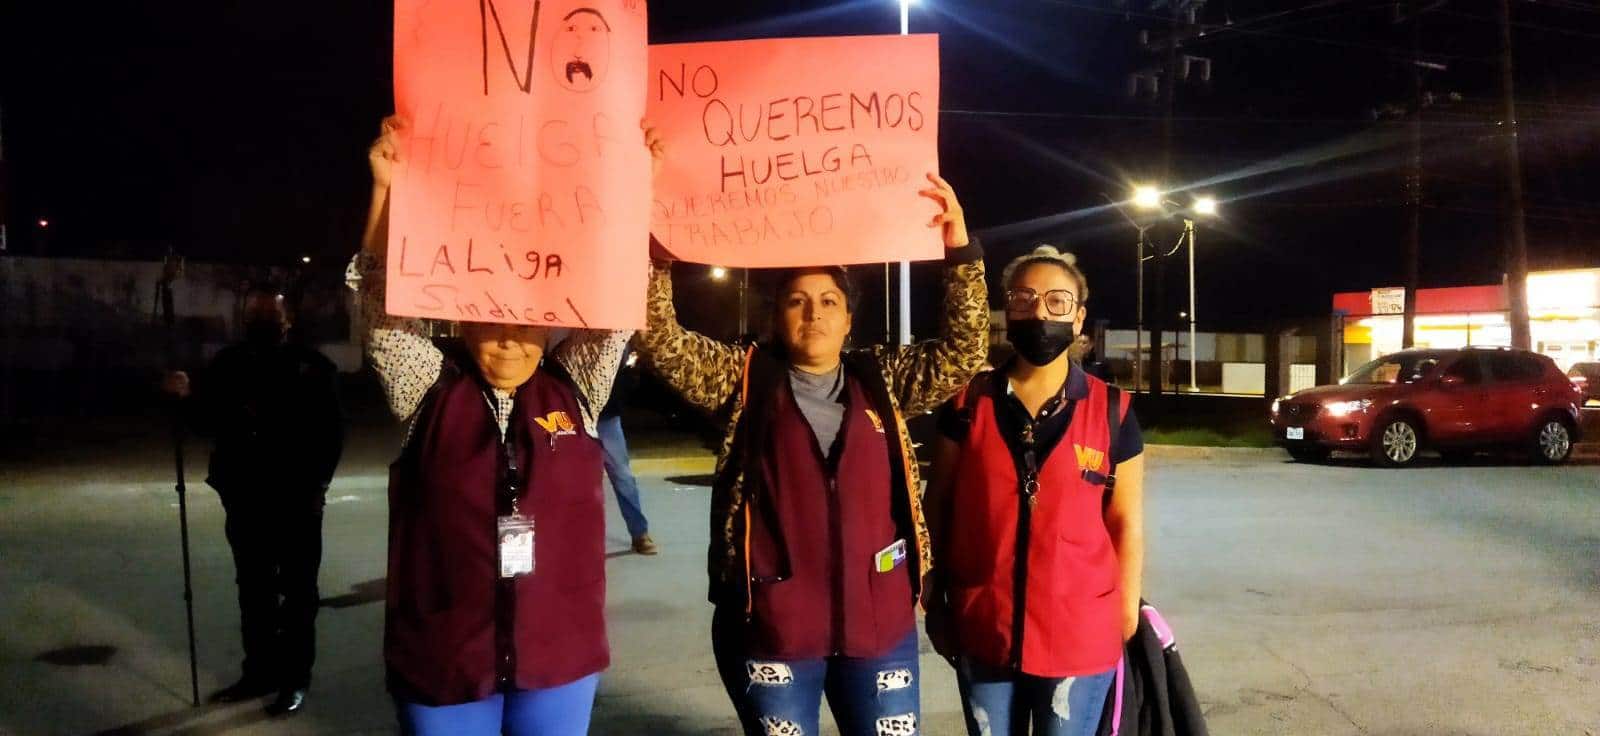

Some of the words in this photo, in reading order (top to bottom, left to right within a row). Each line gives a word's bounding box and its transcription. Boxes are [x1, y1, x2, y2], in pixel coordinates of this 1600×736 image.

[659, 63, 718, 100] NO
[702, 91, 924, 146] QUEREMOS
[721, 143, 872, 193] HUELGA
[451, 181, 606, 233] FUERA
[652, 205, 834, 247] TRABAJO
[414, 285, 588, 327] Sindical
